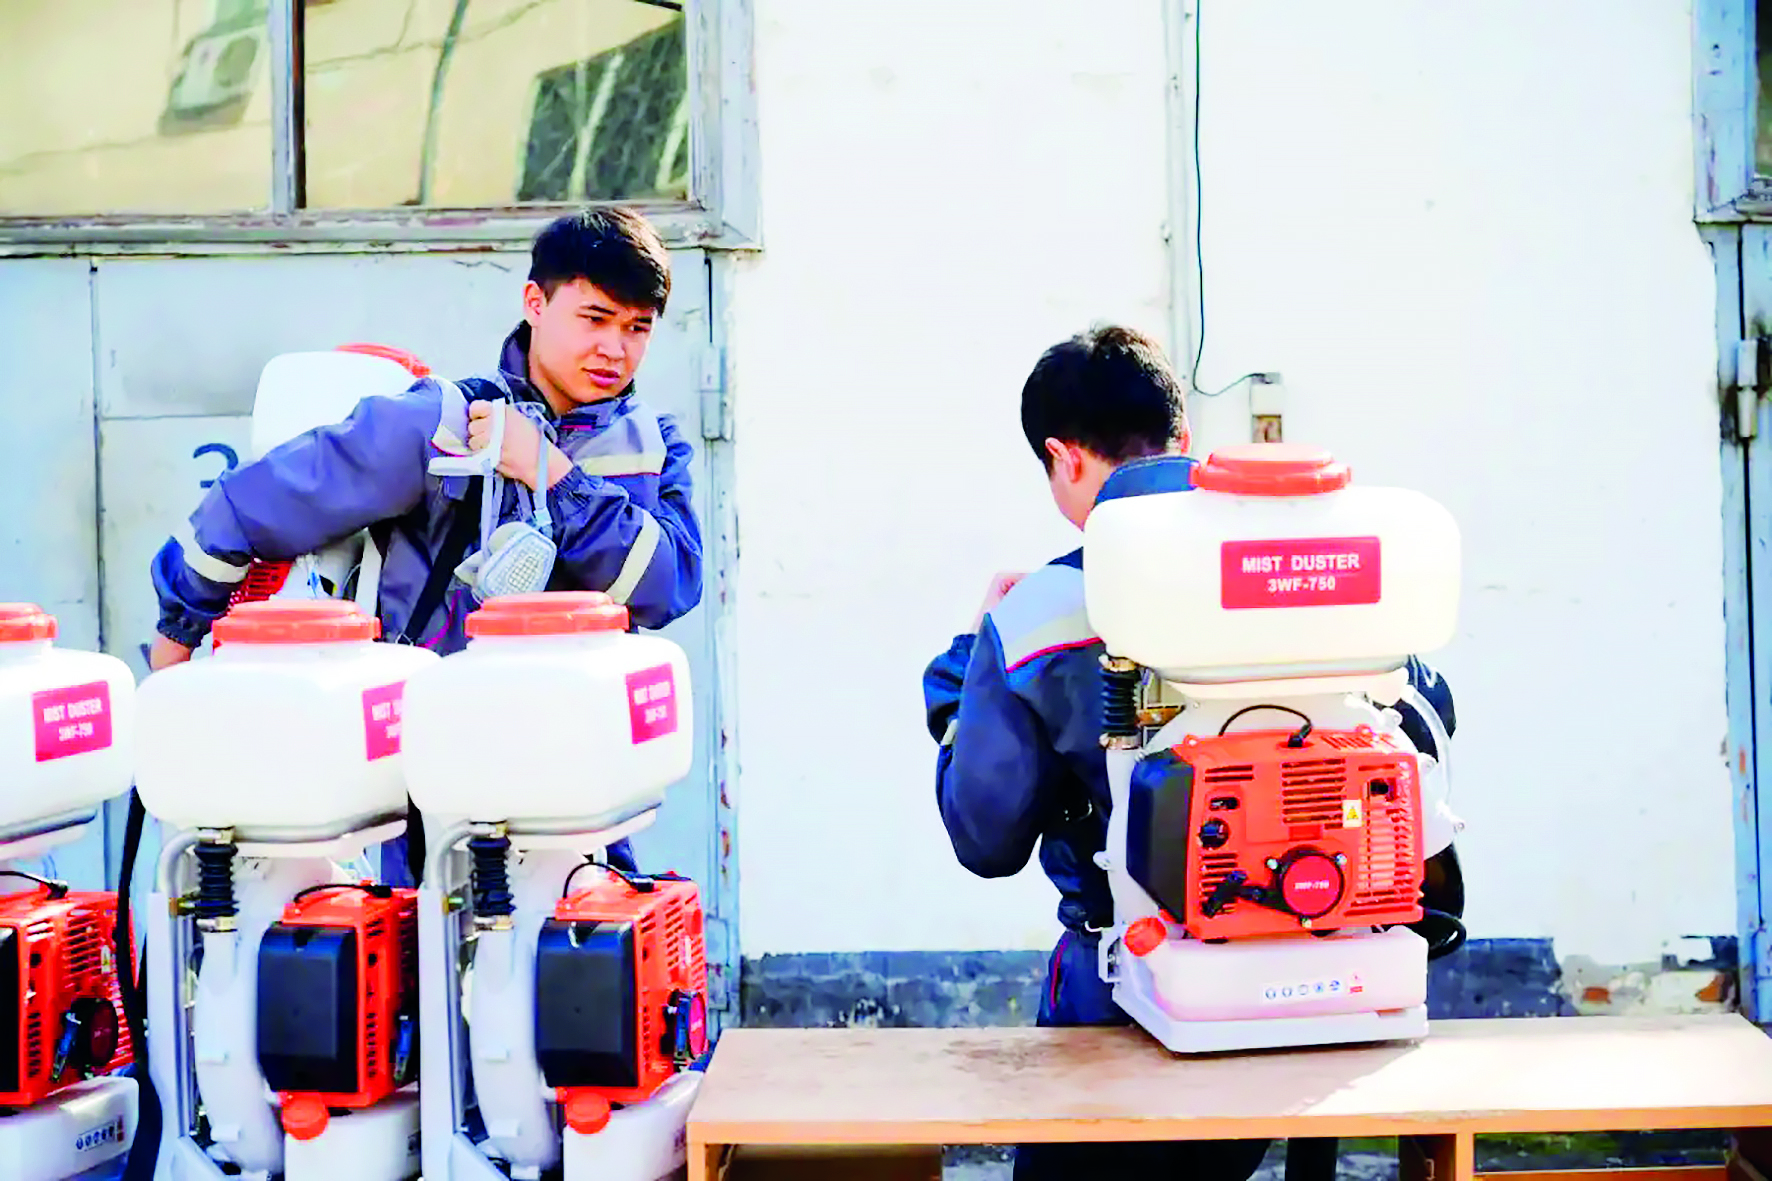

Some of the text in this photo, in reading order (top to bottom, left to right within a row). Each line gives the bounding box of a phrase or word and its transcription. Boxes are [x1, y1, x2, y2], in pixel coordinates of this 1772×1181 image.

[1242, 553, 1360, 573] MIST DUSTER
[1267, 576, 1336, 593] 3WF-750
